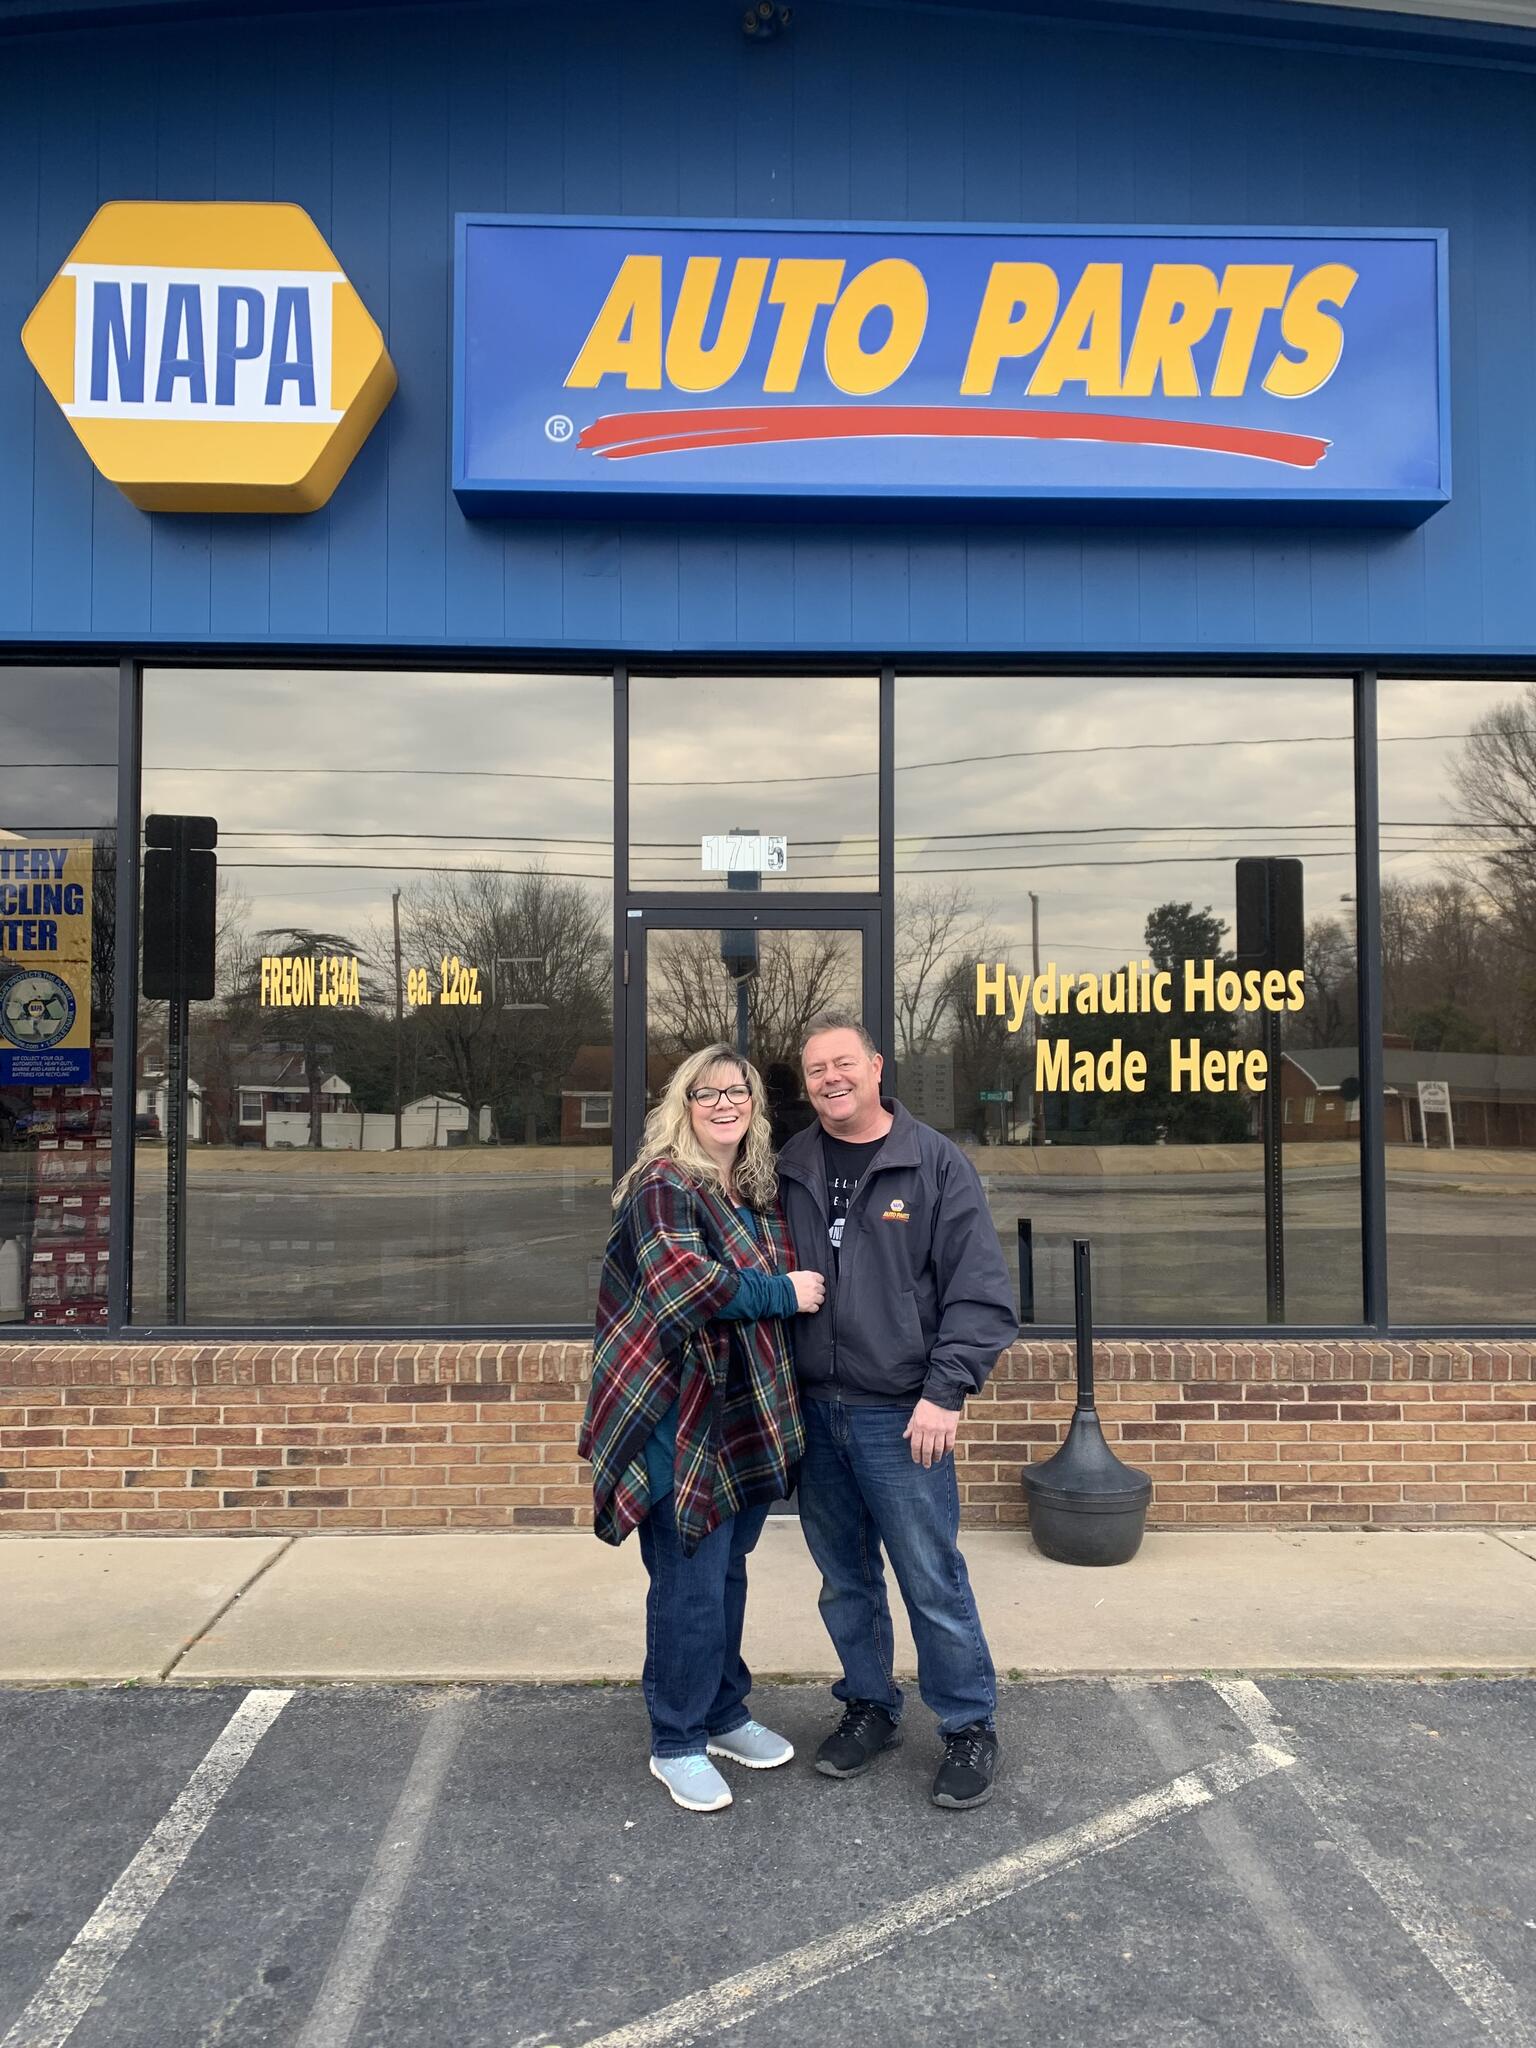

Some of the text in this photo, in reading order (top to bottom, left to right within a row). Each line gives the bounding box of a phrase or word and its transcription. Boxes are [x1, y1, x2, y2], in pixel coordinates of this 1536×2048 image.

[90, 281, 316, 406] NAPA
[562, 253, 1359, 398] AUTO PARTS
[0, 849, 68, 879] TERY
[706, 836, 785, 870] 1715
[0, 883, 84, 915] CLING
[0, 920, 57, 950] TER
[261, 955, 482, 1006] FREON 134A ea. 12oz.
[976, 959, 1305, 1032] Hydraulic Hoses
[1035, 1038, 1268, 1092] Made Here
